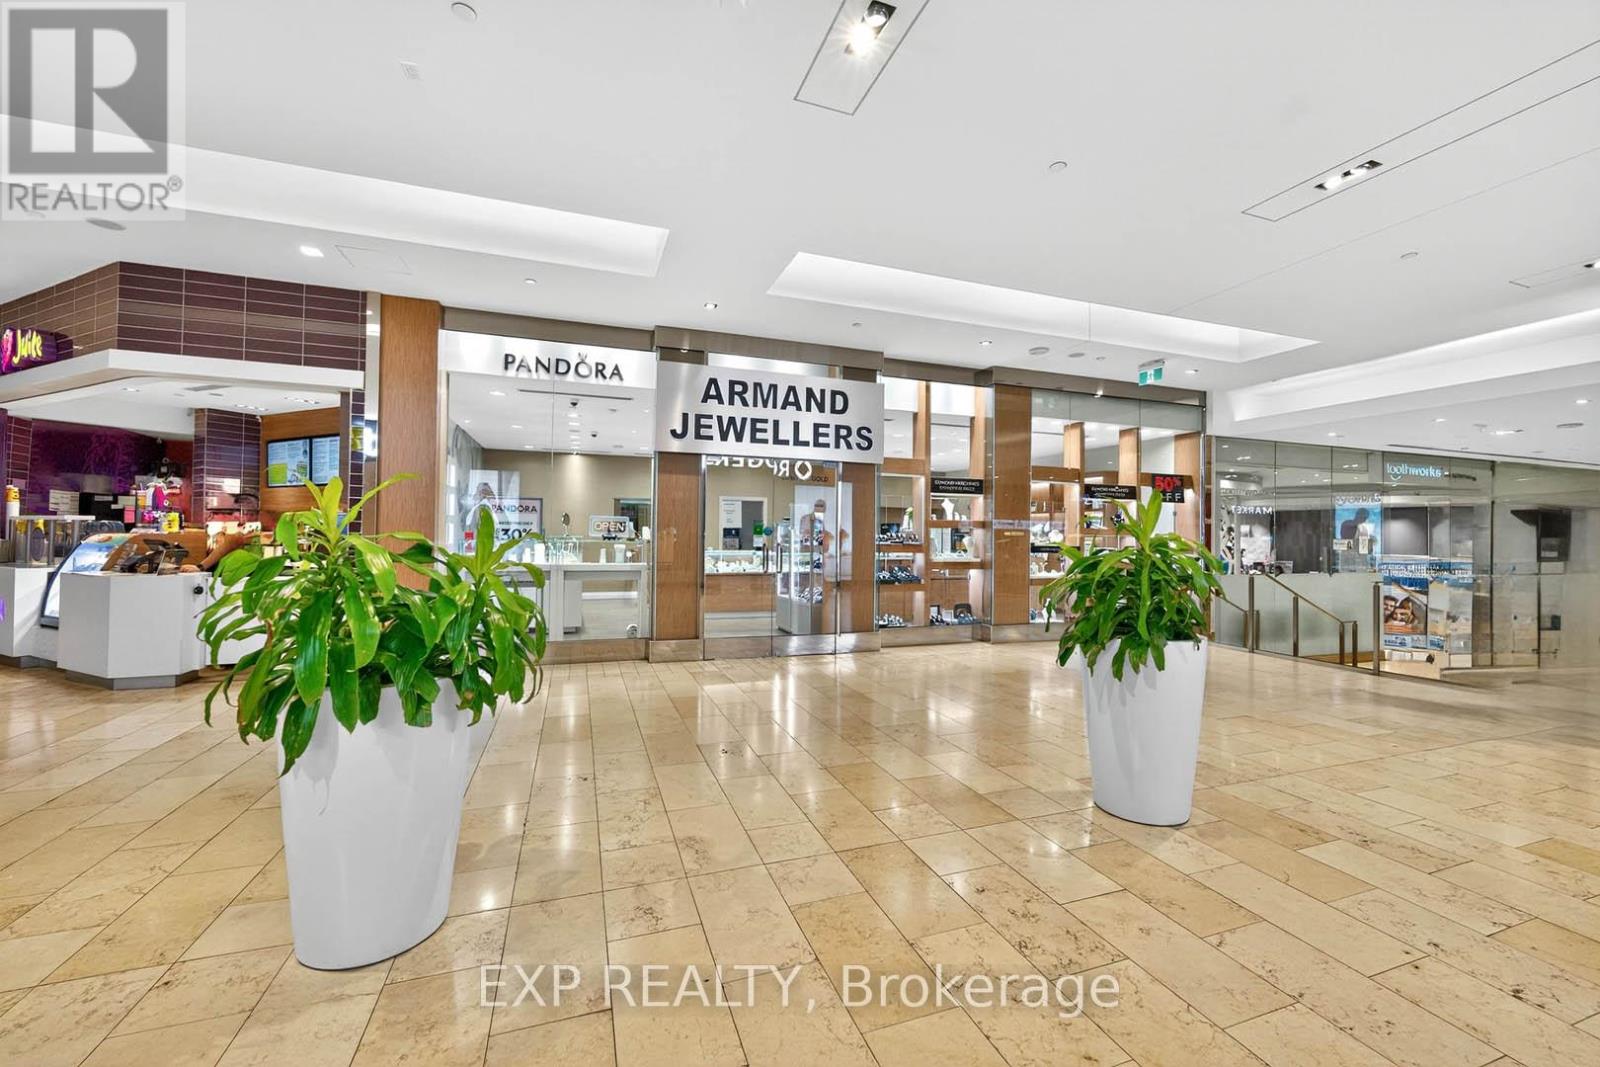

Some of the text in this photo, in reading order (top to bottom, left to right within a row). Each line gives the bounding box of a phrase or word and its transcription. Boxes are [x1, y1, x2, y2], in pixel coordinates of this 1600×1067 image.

[12, 329, 42, 364] Juice
[503, 352, 624, 381] PANDORA
[701, 377, 849, 415] ARMAND
[670, 412, 873, 451] JEWELLERS
[491, 504, 538, 513] PANDORA
[1162, 492, 1181, 502] FF
[594, 521, 626, 532] OPEN
